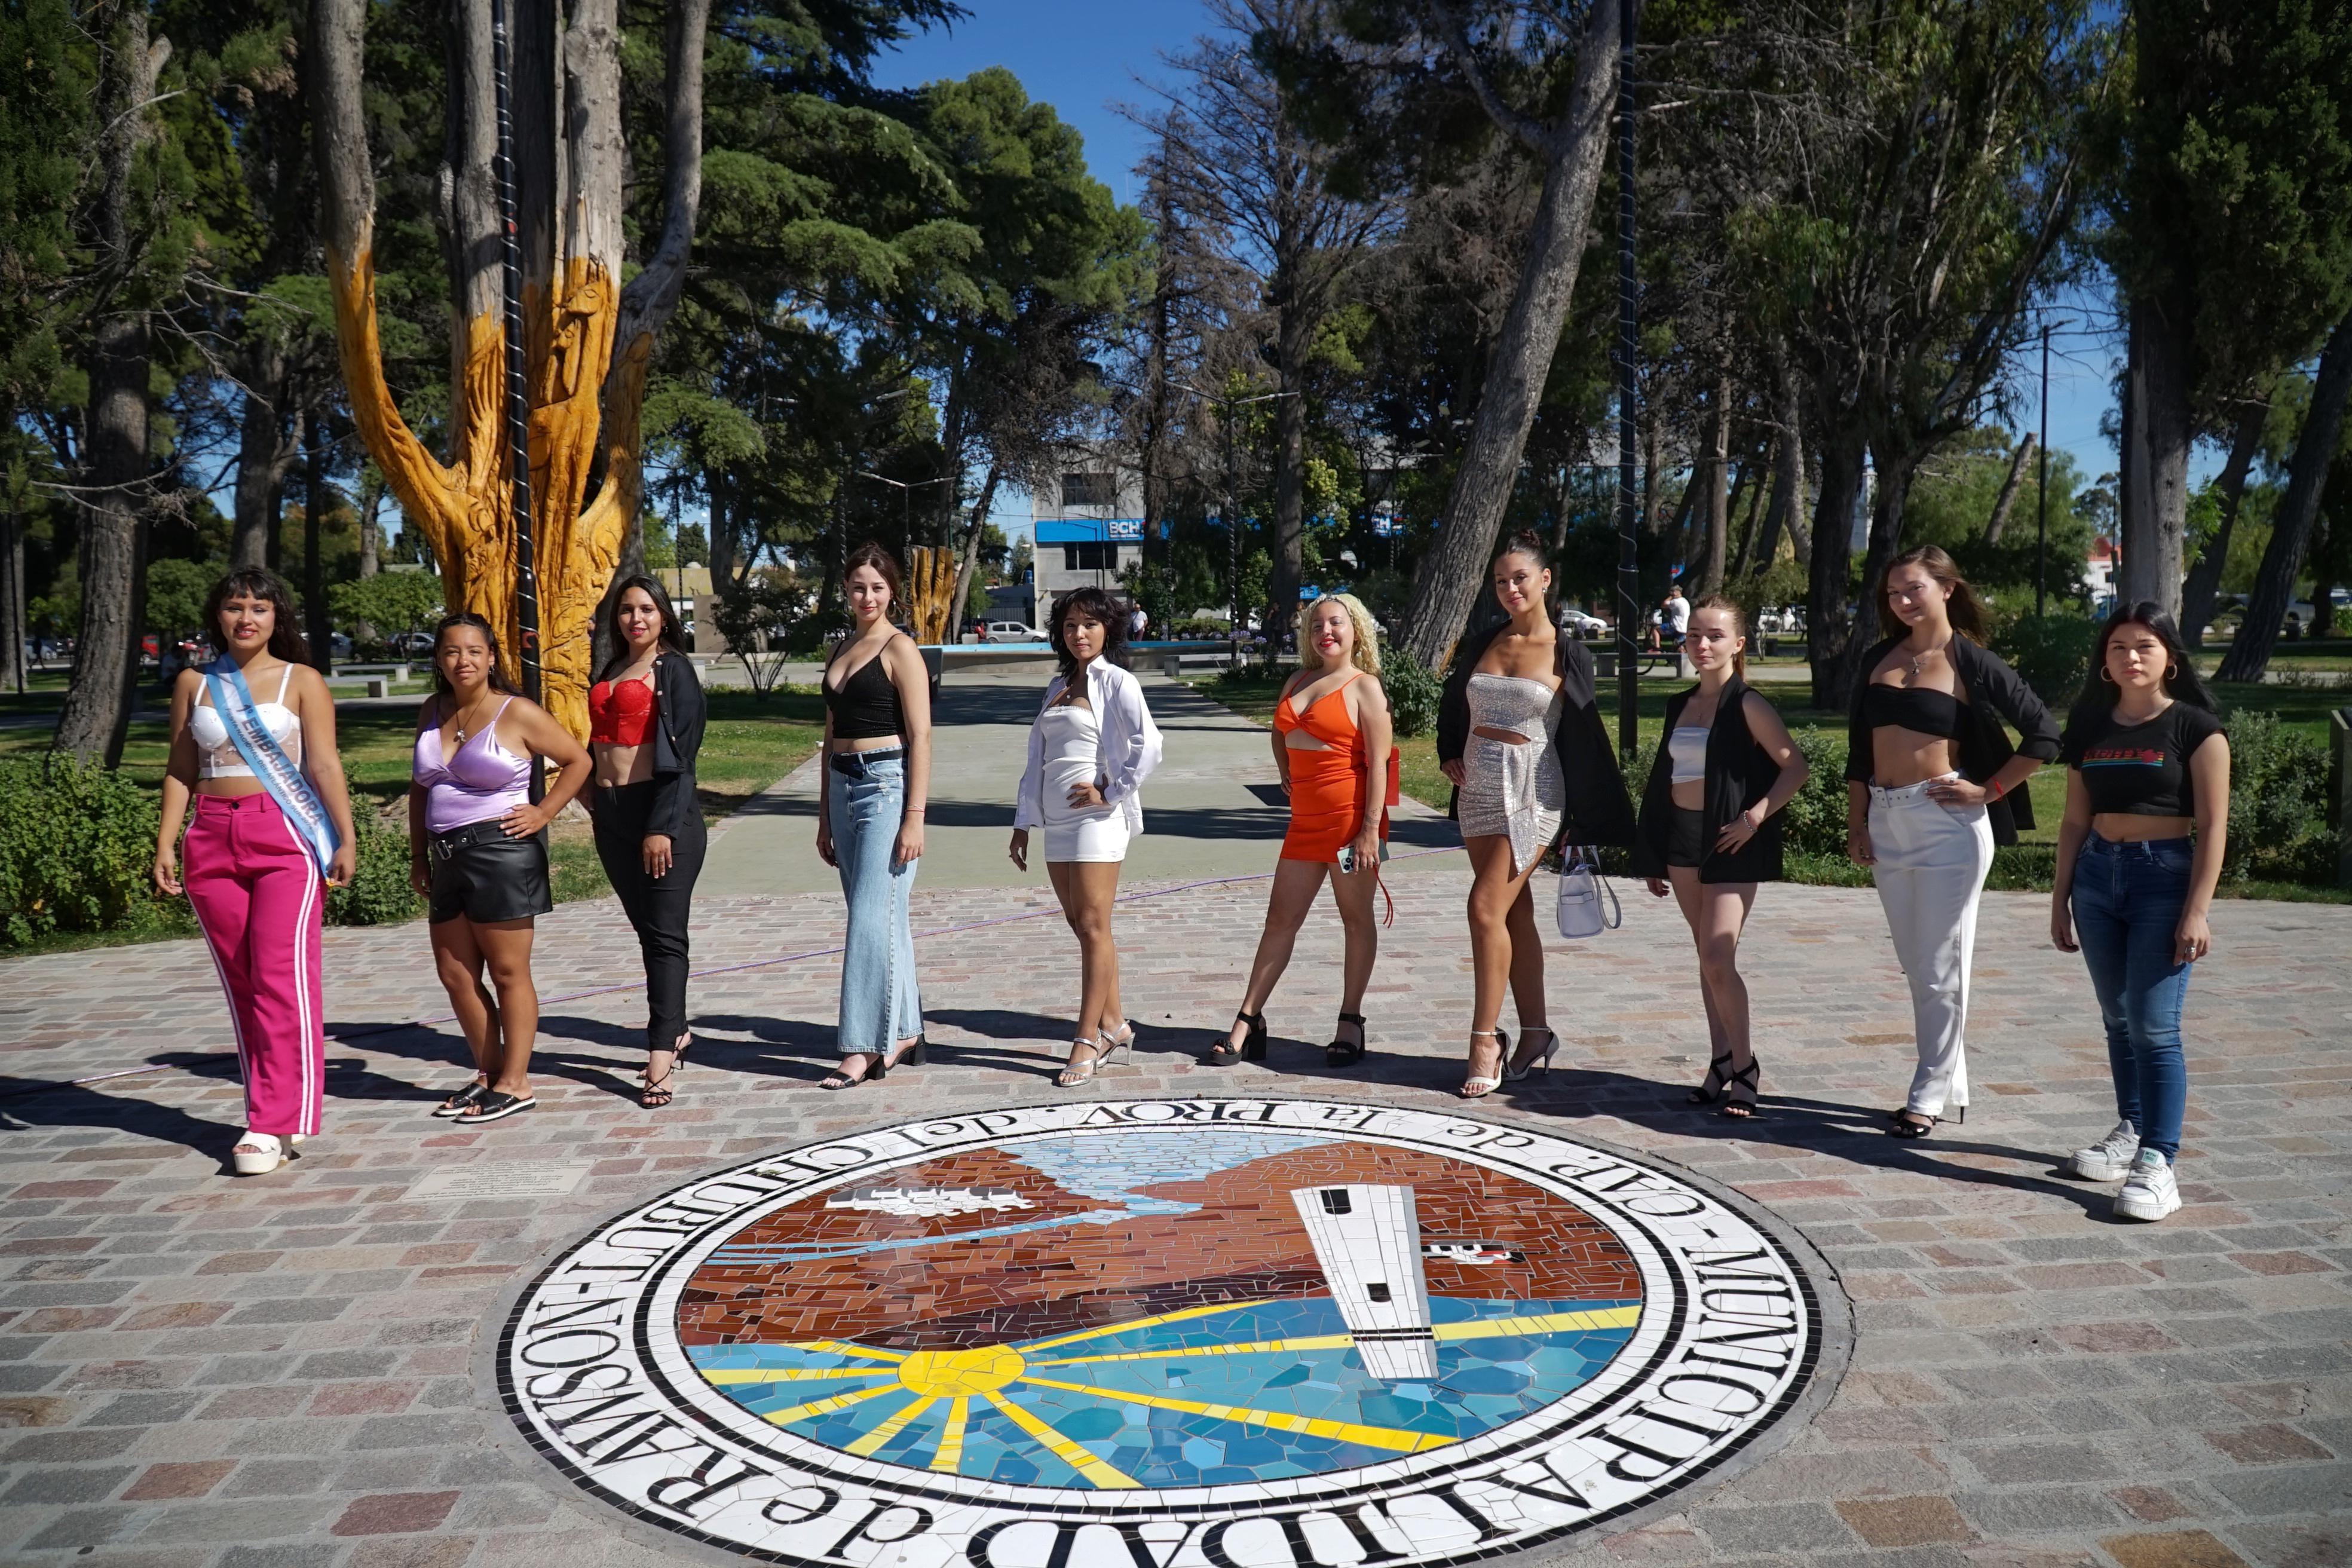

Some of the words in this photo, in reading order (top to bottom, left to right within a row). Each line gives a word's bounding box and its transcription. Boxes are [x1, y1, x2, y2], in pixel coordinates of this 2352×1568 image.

[1109, 521, 1140, 534] BCH
[236, 728, 259, 760] NACIONAL
[258, 760, 269, 774] DEL
[241, 718, 325, 826] EMBAJADORA
[883, 1114, 1018, 1149] del
[1319, 1105, 1383, 1130] la
[1447, 1122, 1536, 1150] de
[564, 1144, 874, 1282] CHUBUT
[1549, 1154, 1707, 1224] CAP.
[519, 1297, 773, 1518] RAWSON
[966, 1246, 1797, 1567] MUNICIPALIDAD
[761, 1485, 934, 1558] de
